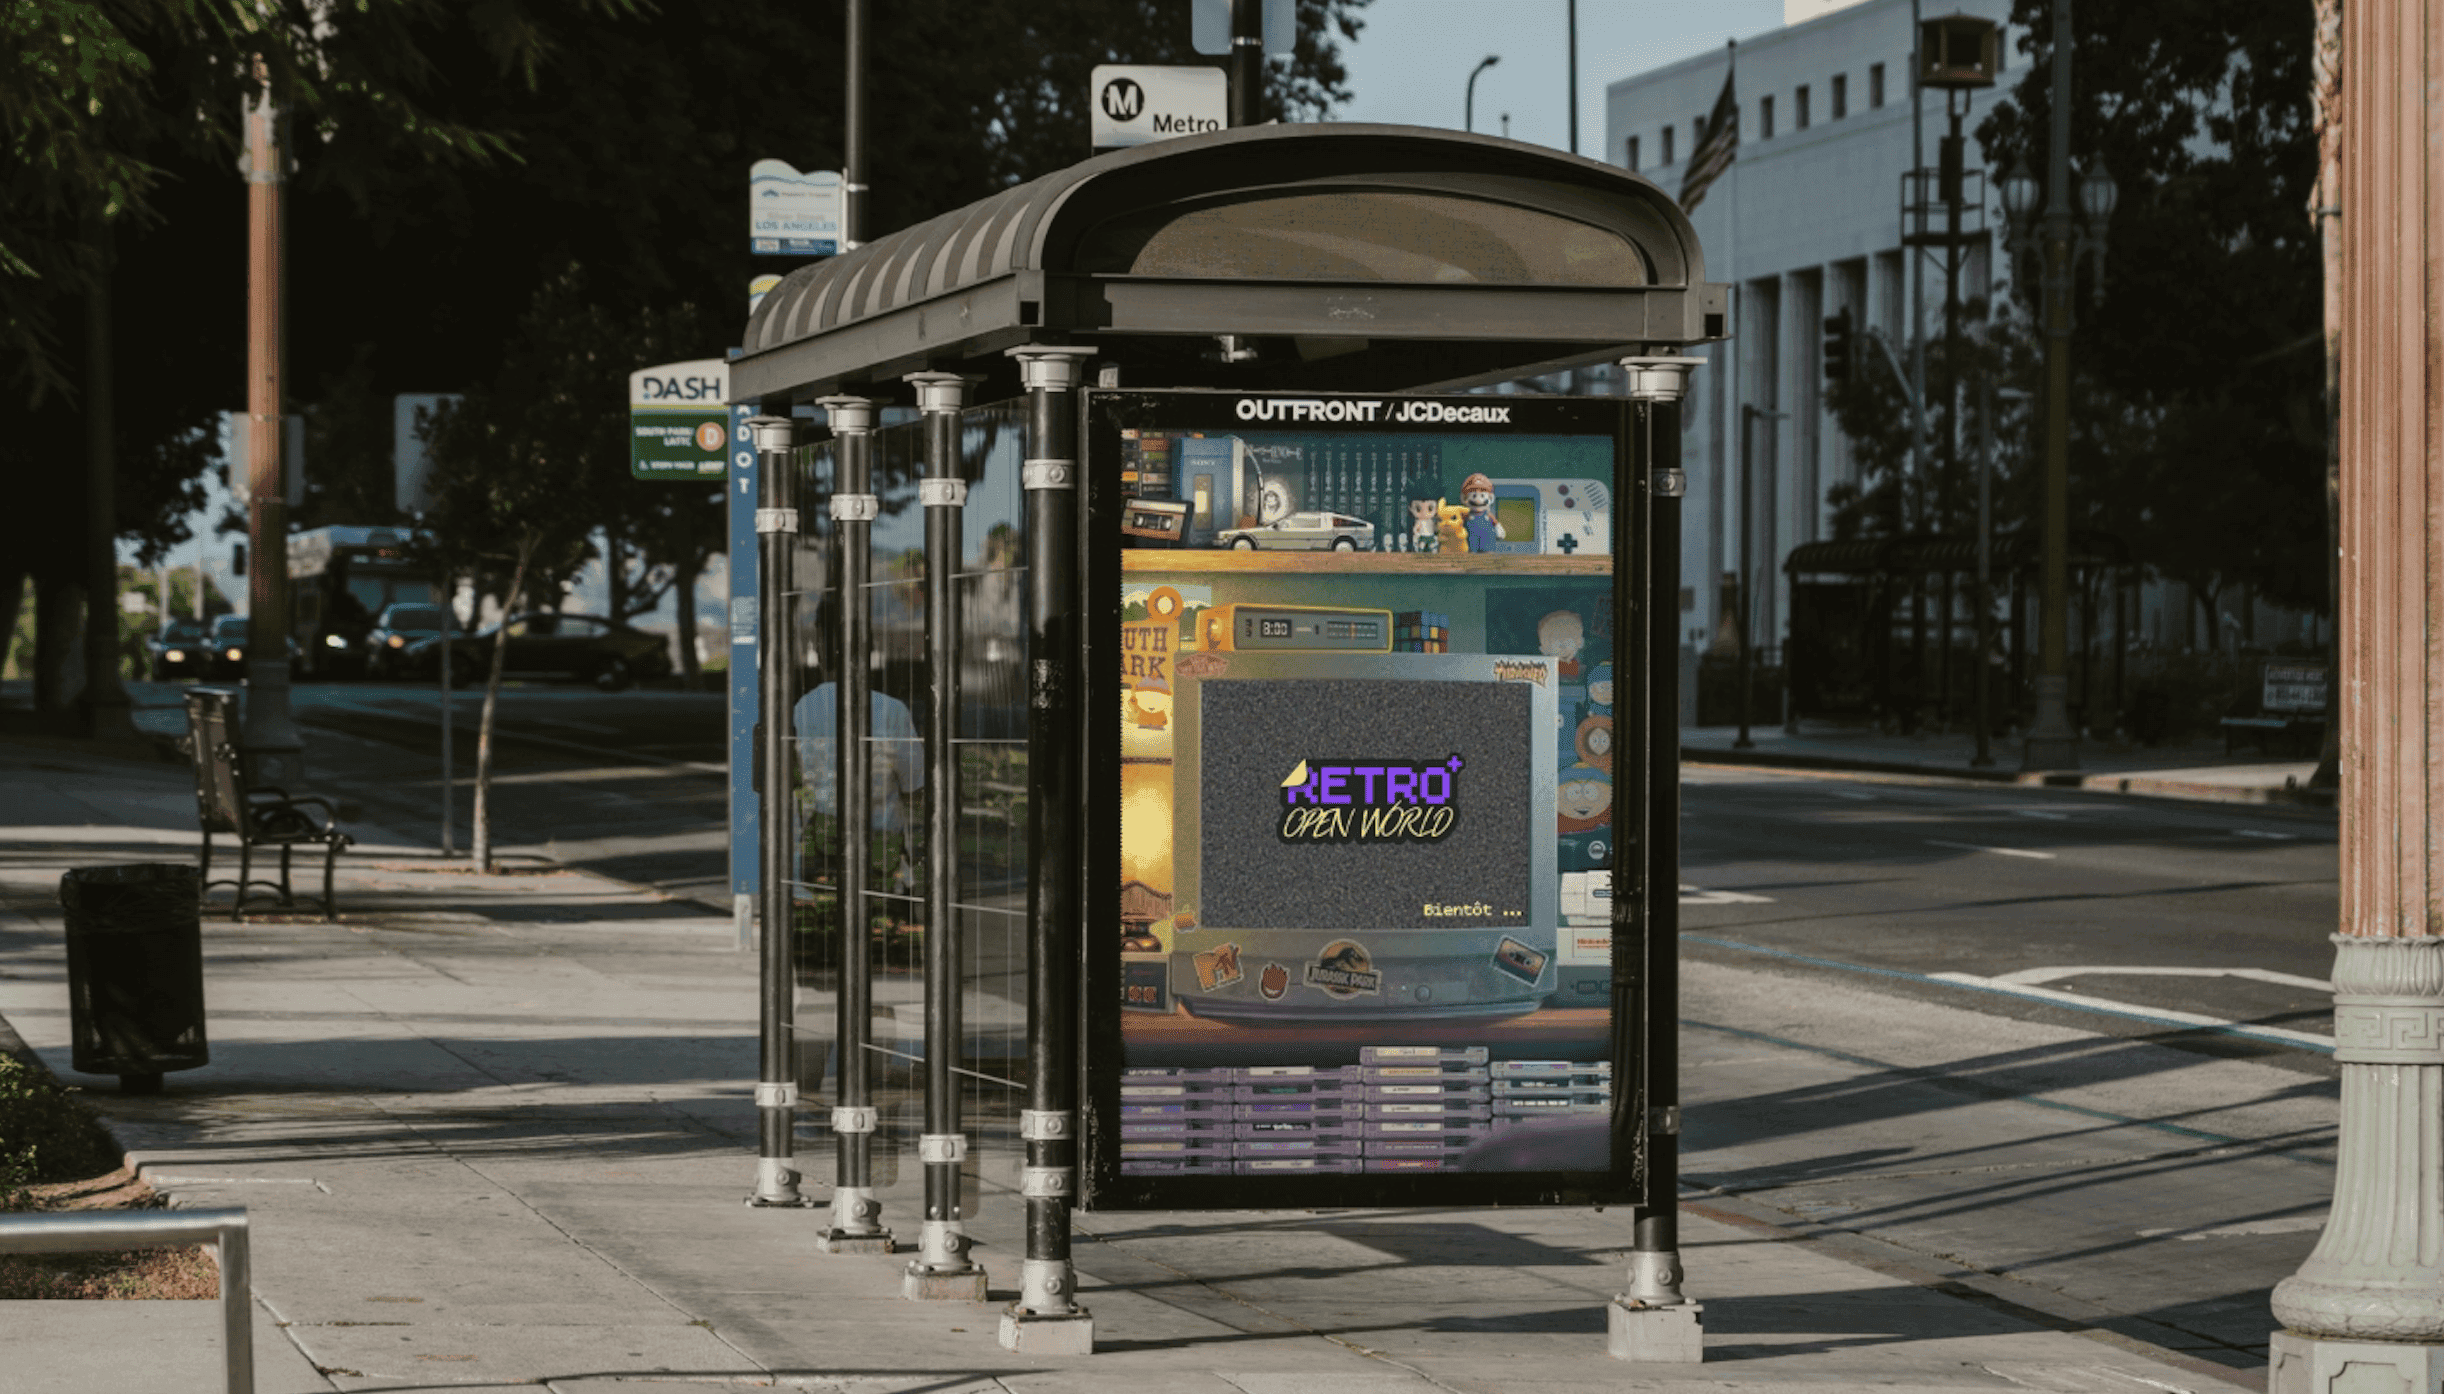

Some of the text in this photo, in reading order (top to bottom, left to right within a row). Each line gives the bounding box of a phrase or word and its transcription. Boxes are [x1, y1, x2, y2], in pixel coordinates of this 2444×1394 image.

[1153, 113, 1219, 133] Metro
[643, 376, 721, 401] DASH
[1236, 398, 1511, 423] OUTFRONT / JCDecaux
[1262, 621, 1288, 636] 8:00
[1284, 800, 1454, 839] OPEN WORLD
[1423, 900, 1493, 917] Bientôt
